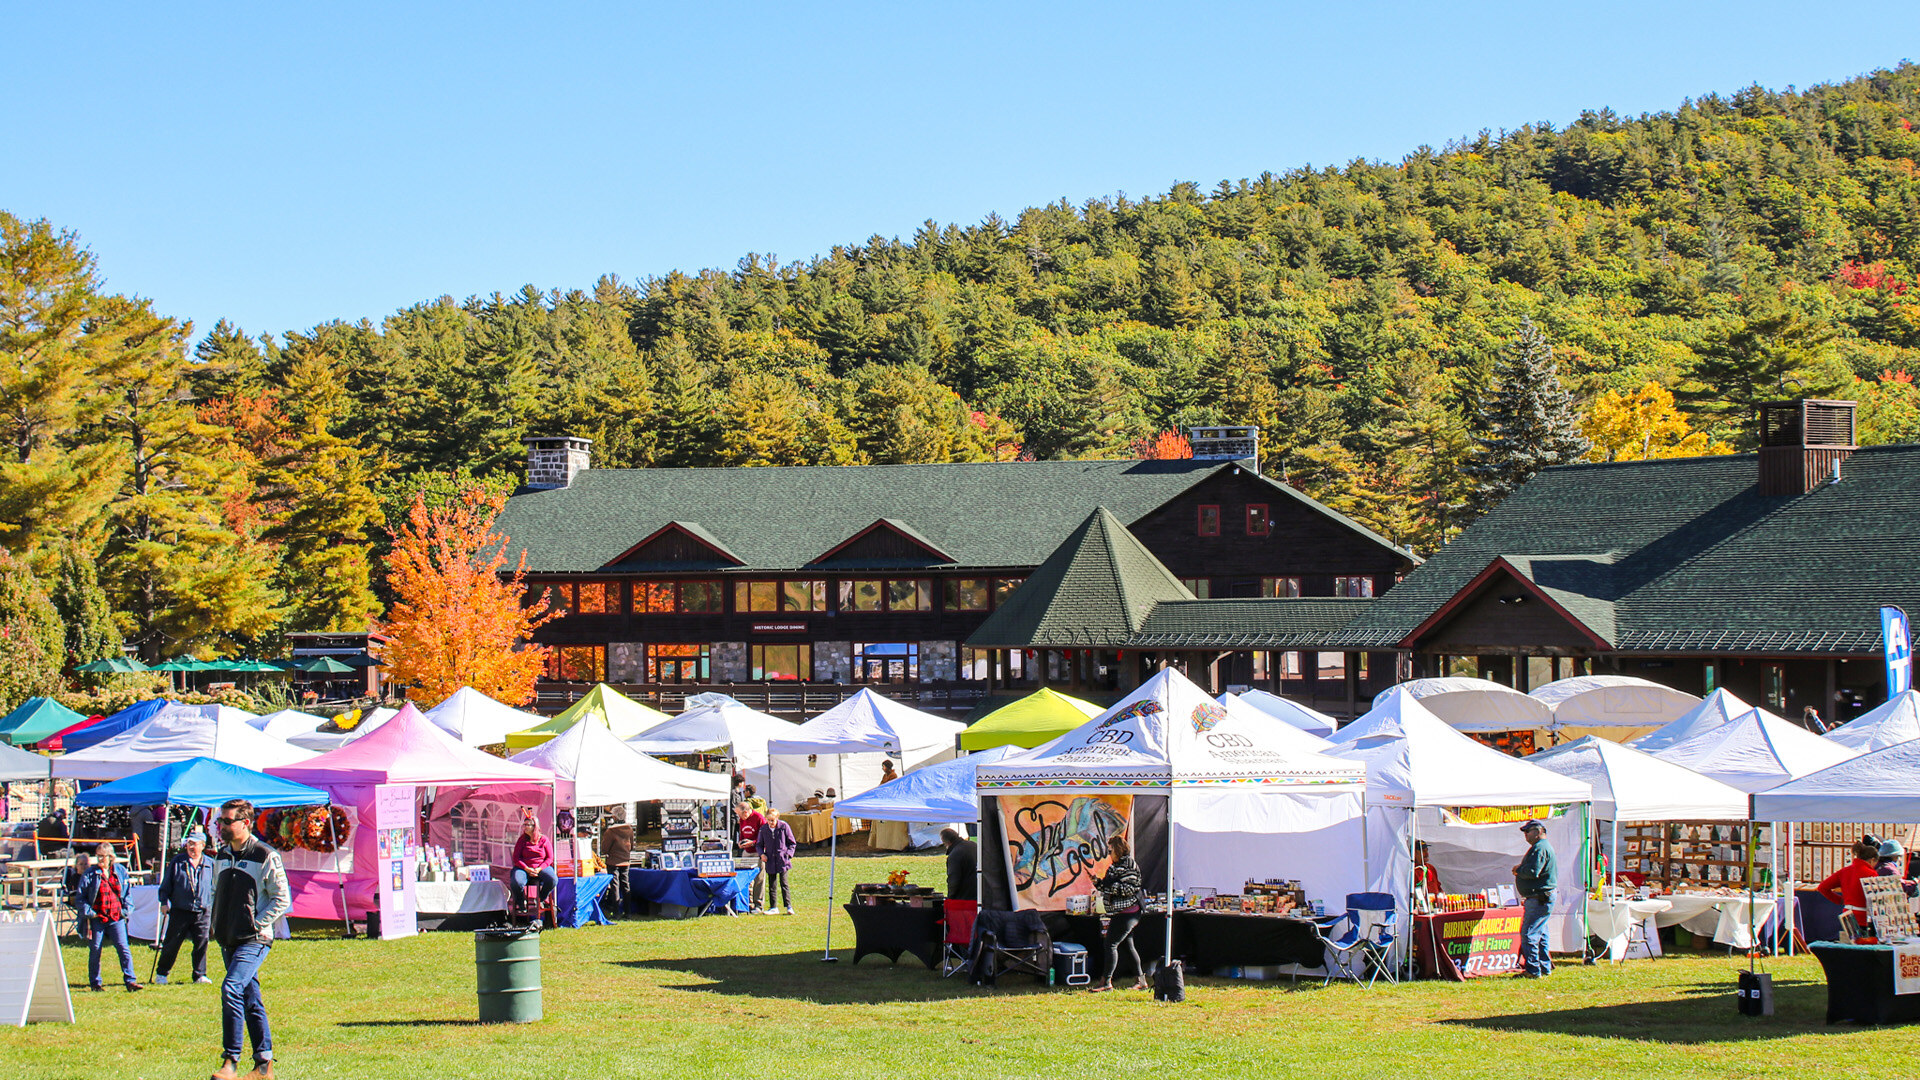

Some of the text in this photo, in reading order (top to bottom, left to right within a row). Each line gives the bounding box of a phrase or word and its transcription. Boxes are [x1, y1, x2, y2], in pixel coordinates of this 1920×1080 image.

[1086, 729, 1134, 744] CBD
[1206, 733, 1253, 748] CBD
[1060, 744, 1132, 757] American
[1208, 749, 1281, 758] American
[1051, 754, 1116, 764] Shaman
[1046, 810, 1108, 898] Local
[1443, 917, 1521, 938] RUBINSHOTSAUCE.COM
[1448, 937, 1513, 955] Crave the Flavor
[1901, 966, 1920, 978] Sug
